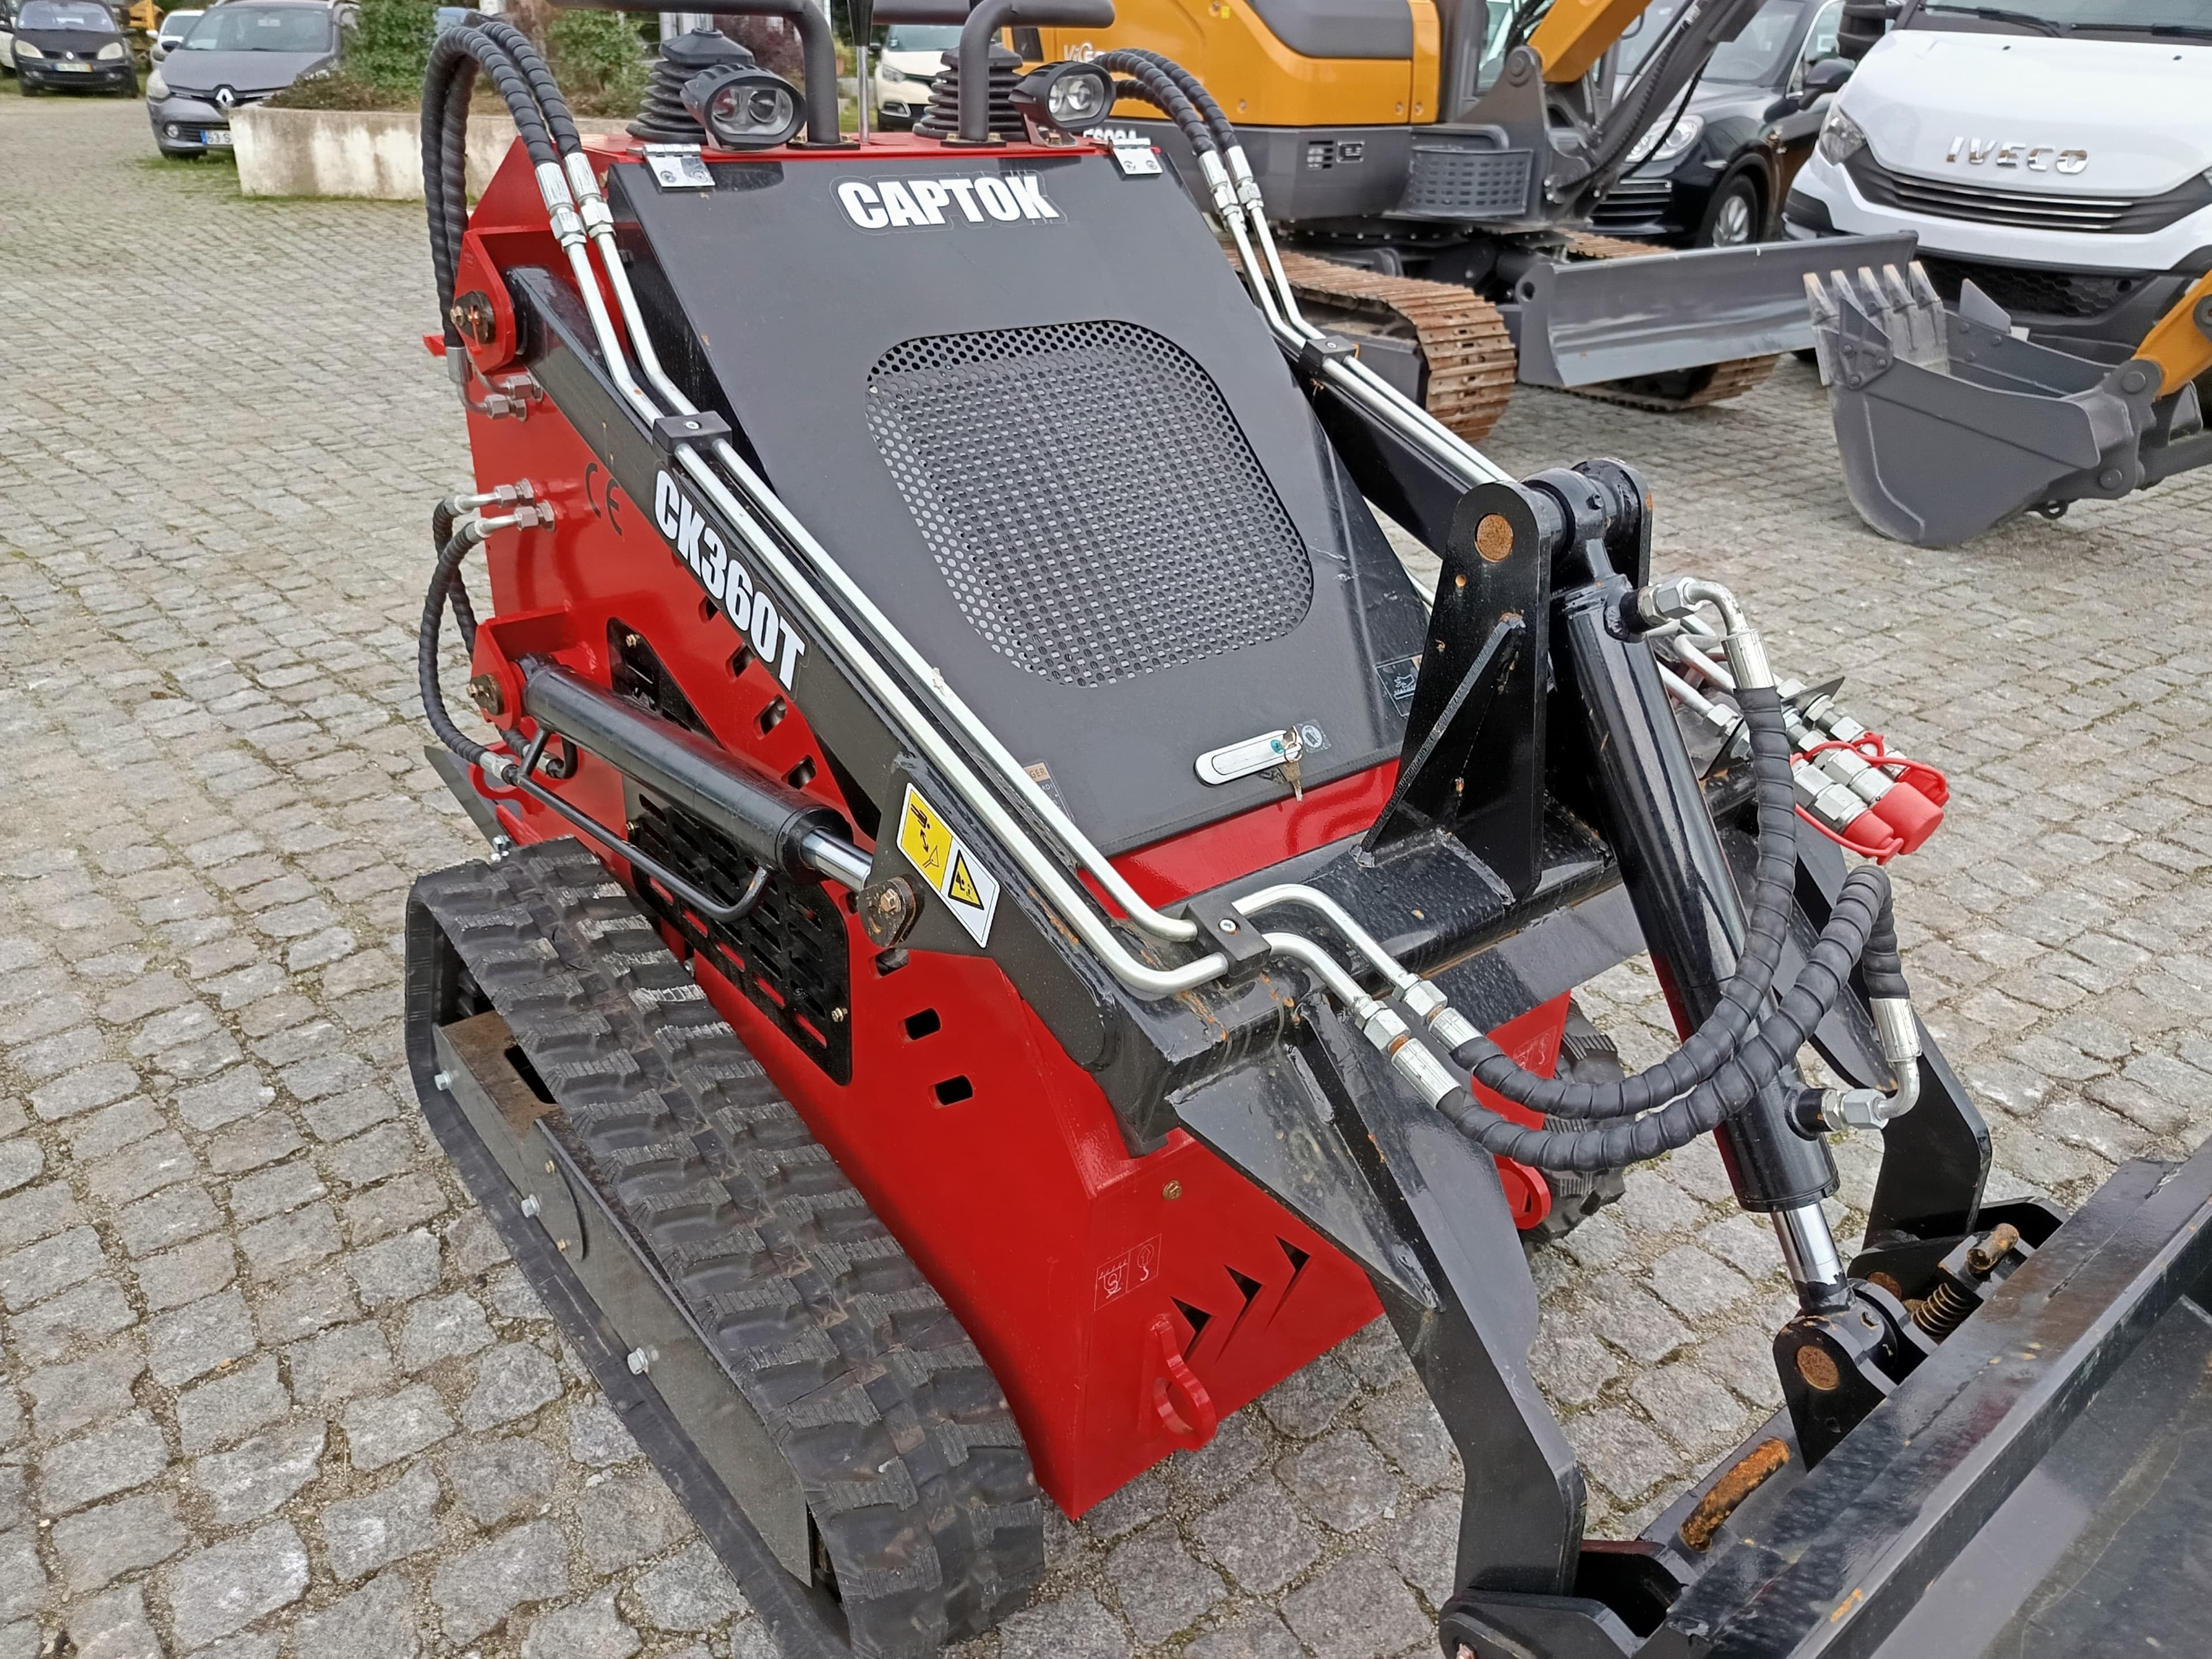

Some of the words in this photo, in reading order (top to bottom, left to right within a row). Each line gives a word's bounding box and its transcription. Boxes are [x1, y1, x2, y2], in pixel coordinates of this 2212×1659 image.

[1946, 136, 2089, 175] IVECO
[838, 176, 1060, 229] CAPTOK
[655, 470, 805, 691] CK360T
[1029, 768, 1047, 778] GER
[1041, 783, 1053, 791] RD!
